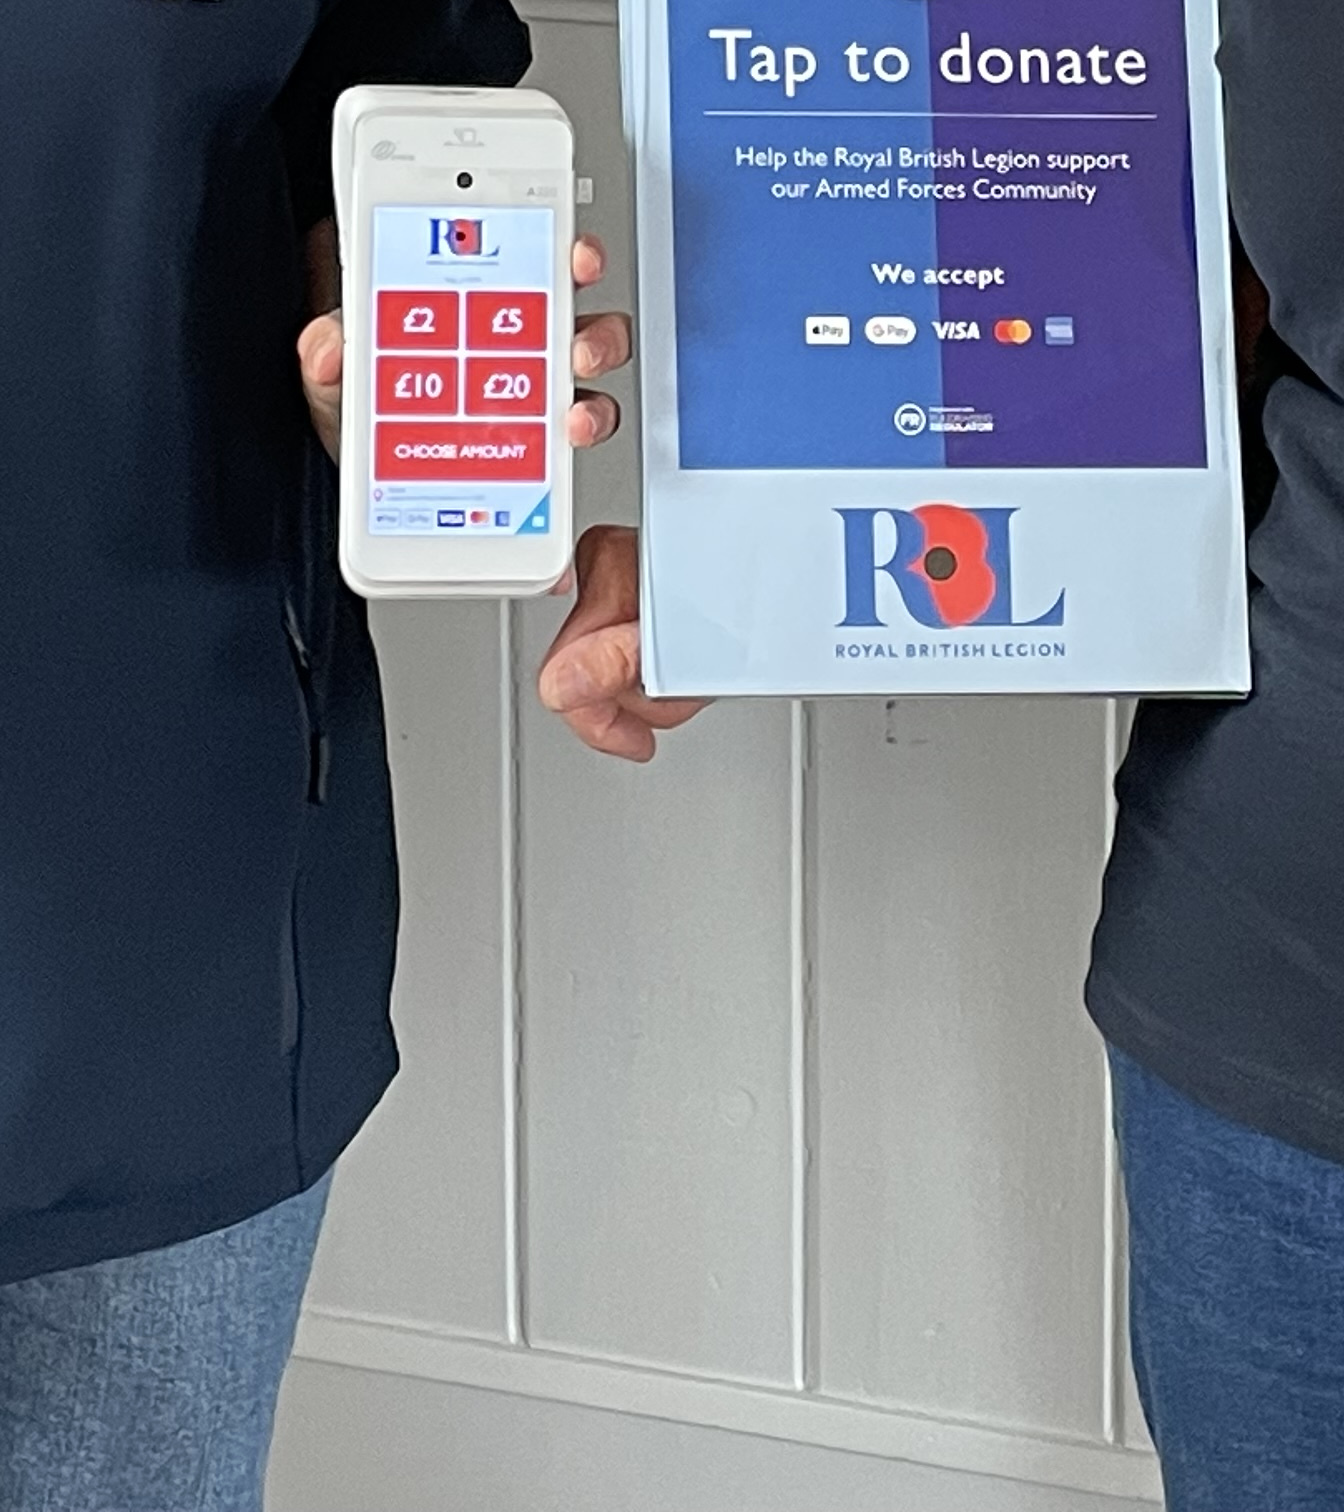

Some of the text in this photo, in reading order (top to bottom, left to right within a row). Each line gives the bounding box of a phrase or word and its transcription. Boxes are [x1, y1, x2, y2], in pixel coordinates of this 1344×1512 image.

[708, 28, 1147, 98] Tap to donate
[735, 147, 1131, 173] Help the Royal British Legion support
[771, 179, 1097, 204] our Armed Forces Community
[870, 263, 1005, 290] We accept
[403, 307, 435, 333] £2
[492, 308, 523, 334] £5
[822, 323, 844, 338] Pay
[931, 320, 981, 340] VISA
[395, 372, 443, 398] £10
[483, 373, 531, 399] £20
[394, 444, 527, 459] CHOOSE AMOUNT
[835, 642, 1066, 659] ROYAL BRITISH LEGION
